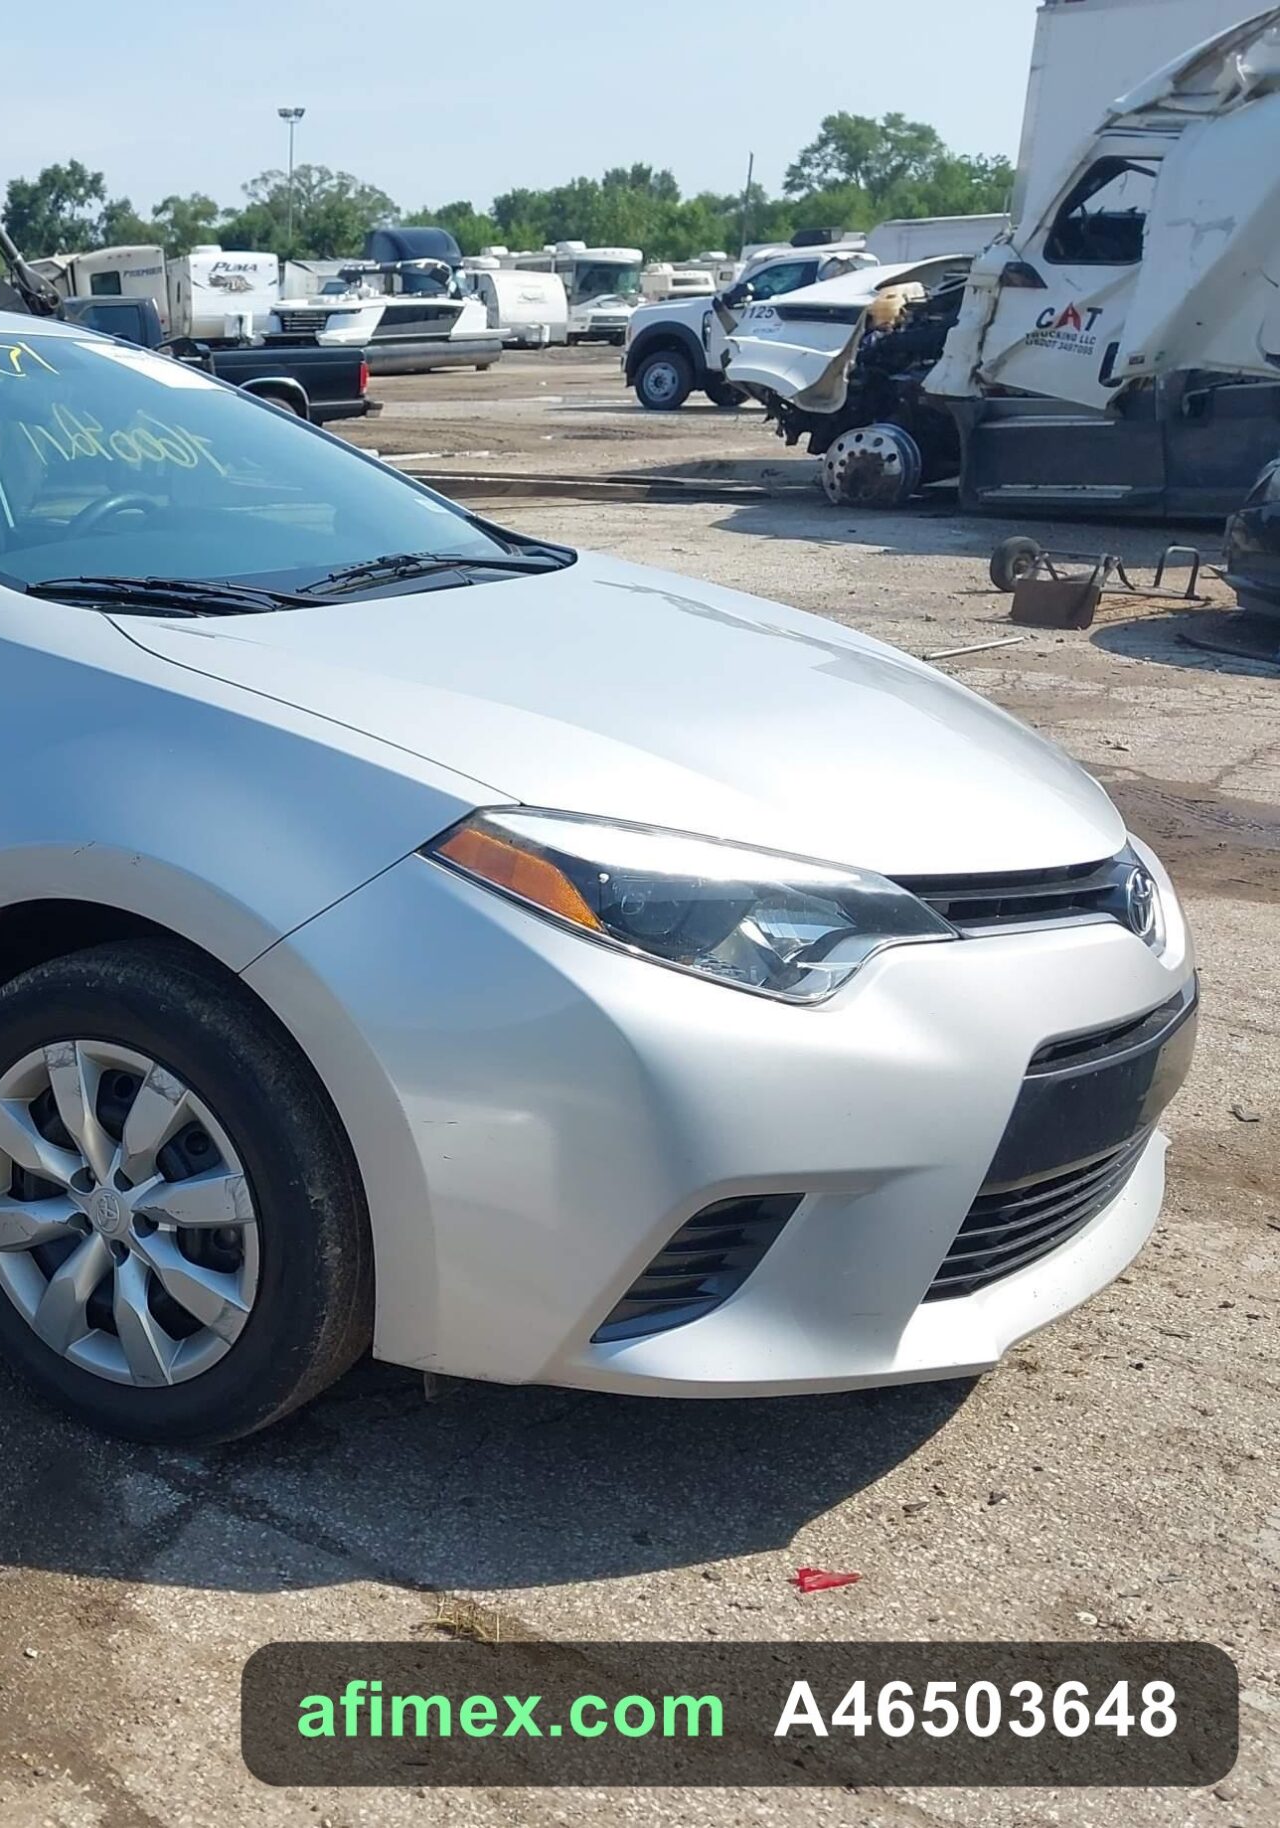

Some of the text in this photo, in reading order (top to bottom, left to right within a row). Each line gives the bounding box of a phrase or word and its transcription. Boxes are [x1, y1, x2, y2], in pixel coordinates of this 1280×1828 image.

[211, 261, 258, 273] PUMA
[1036, 302, 1103, 332] CAT
[1079, 334, 1096, 345] LLC
